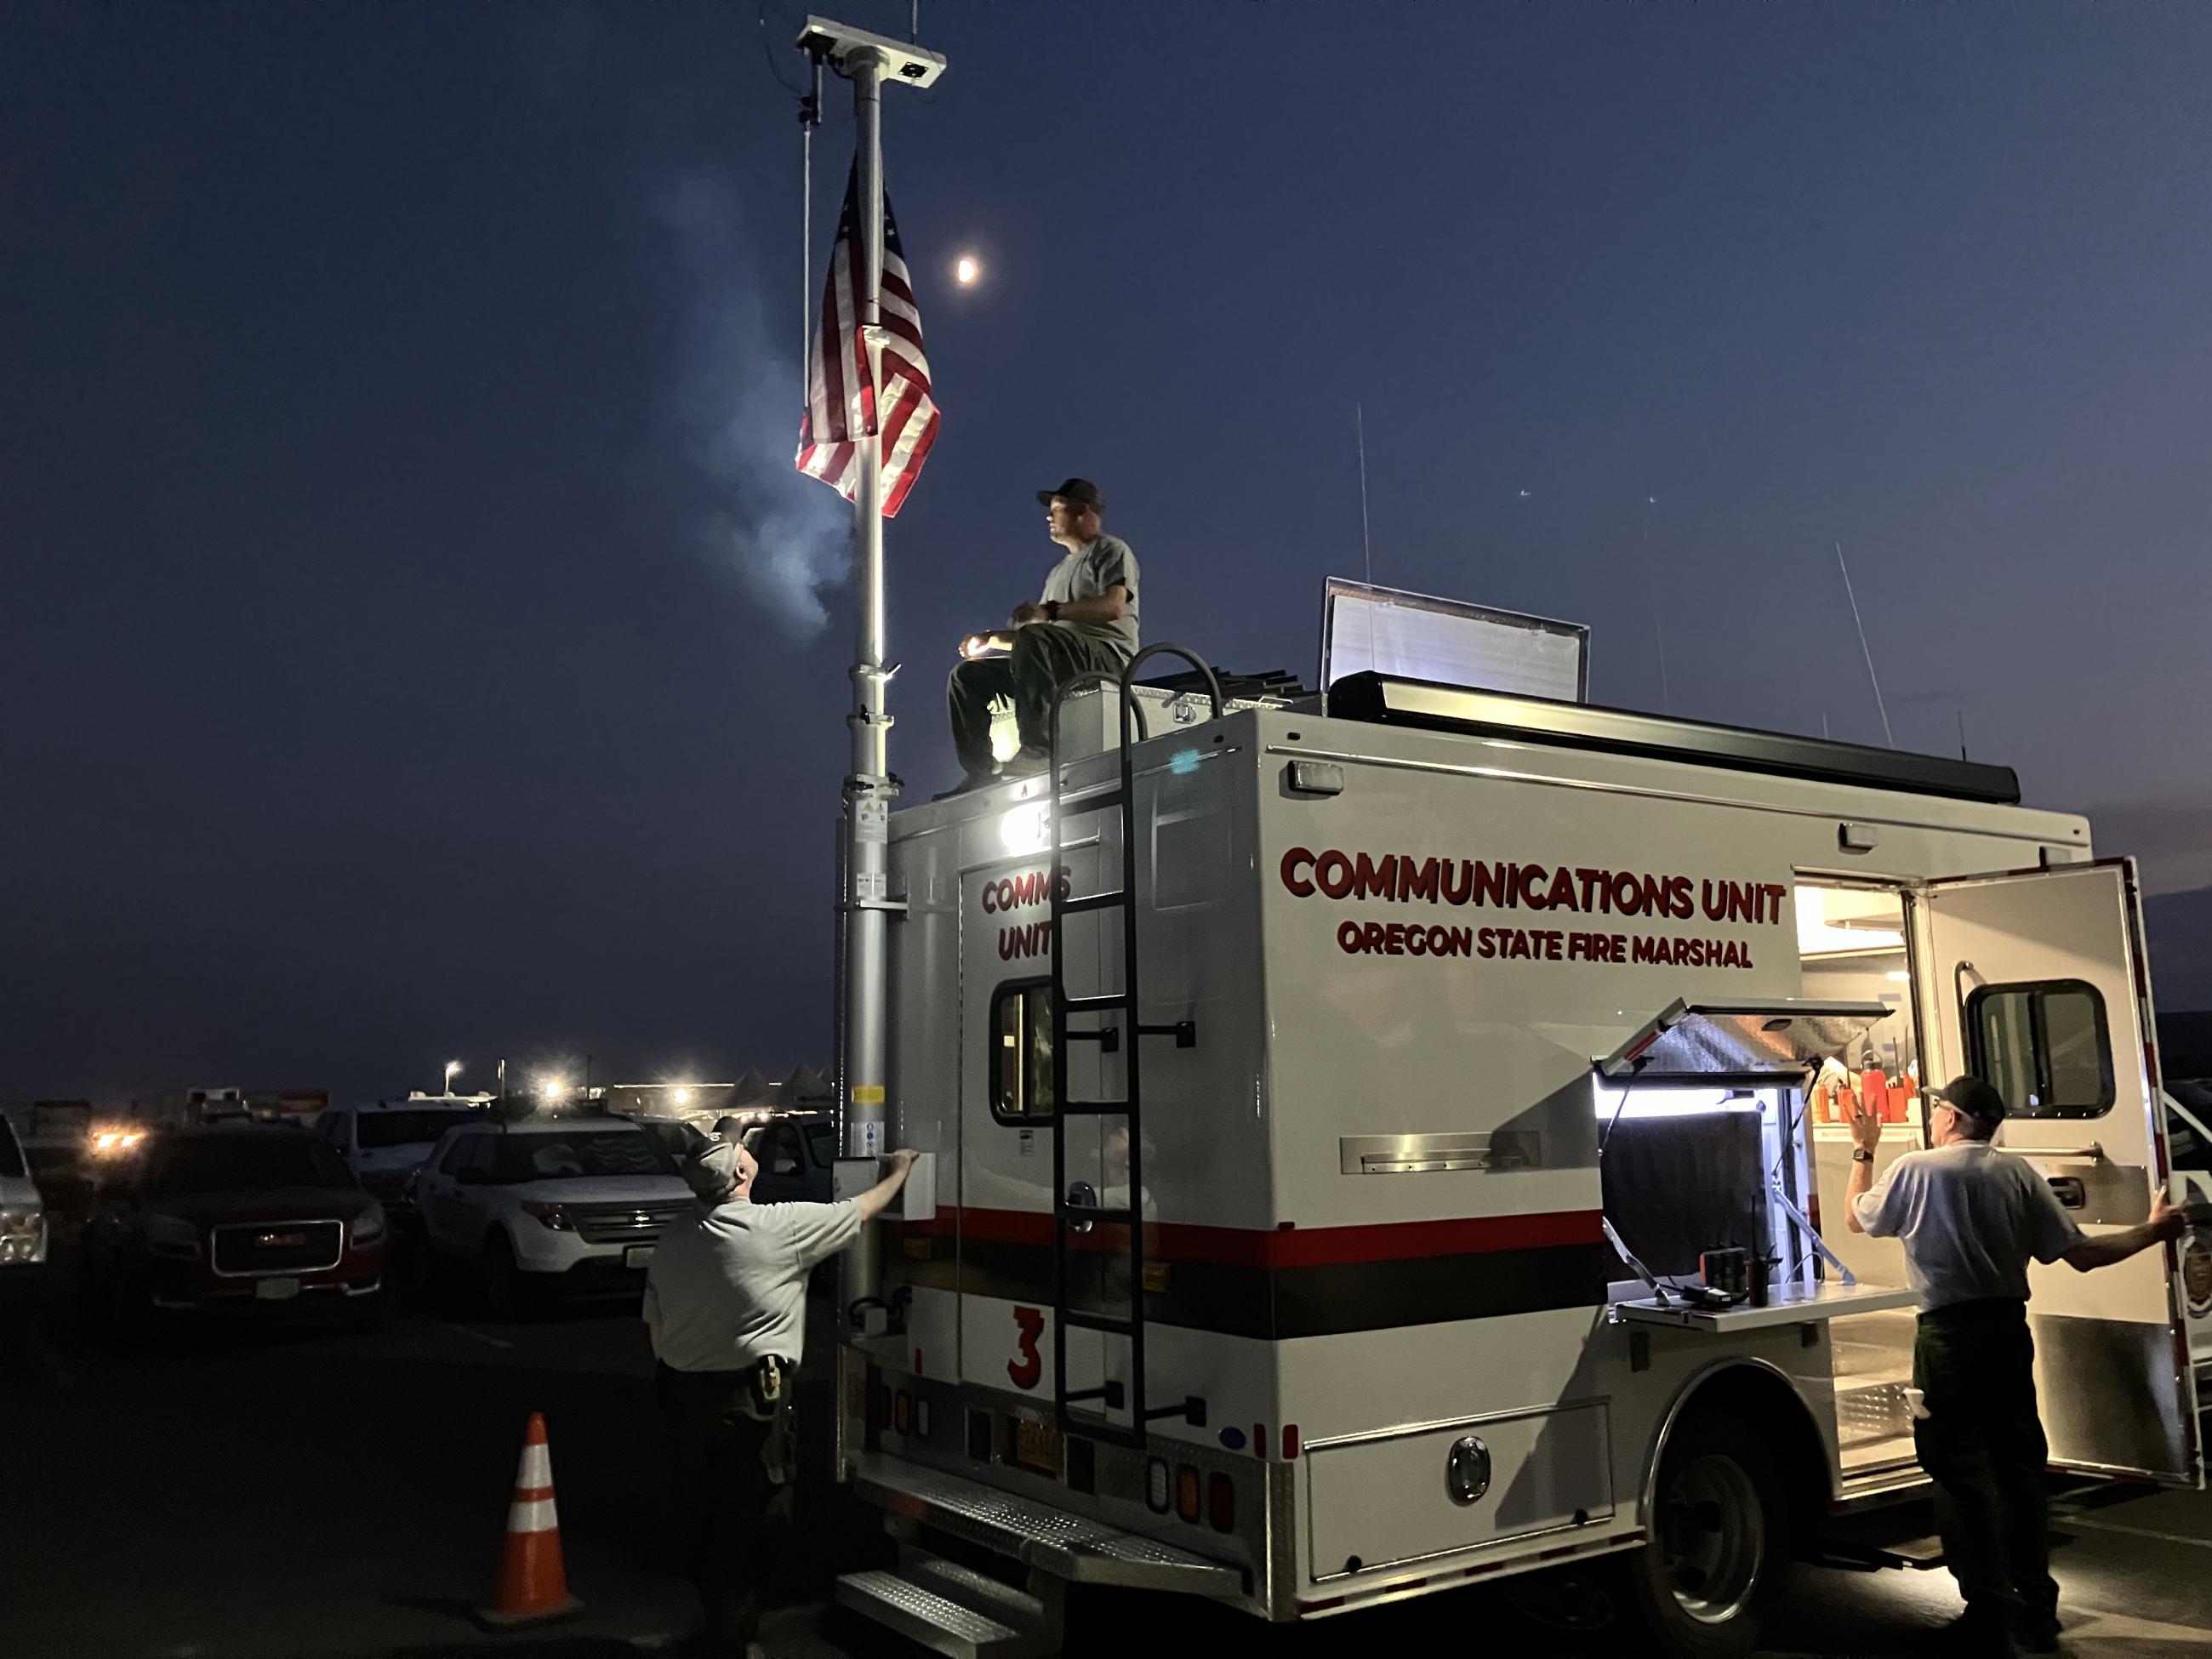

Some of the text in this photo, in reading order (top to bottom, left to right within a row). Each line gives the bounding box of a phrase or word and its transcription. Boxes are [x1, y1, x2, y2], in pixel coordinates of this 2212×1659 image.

[982, 866, 1071, 915] COMMS
[1280, 847, 1786, 925] COMMUNICATIONS UNIT
[999, 921, 1053, 961] UNIT
[1337, 921, 1753, 968] OREGON STATE FIRE MARSHAL
[1008, 1306, 1045, 1389] 3
